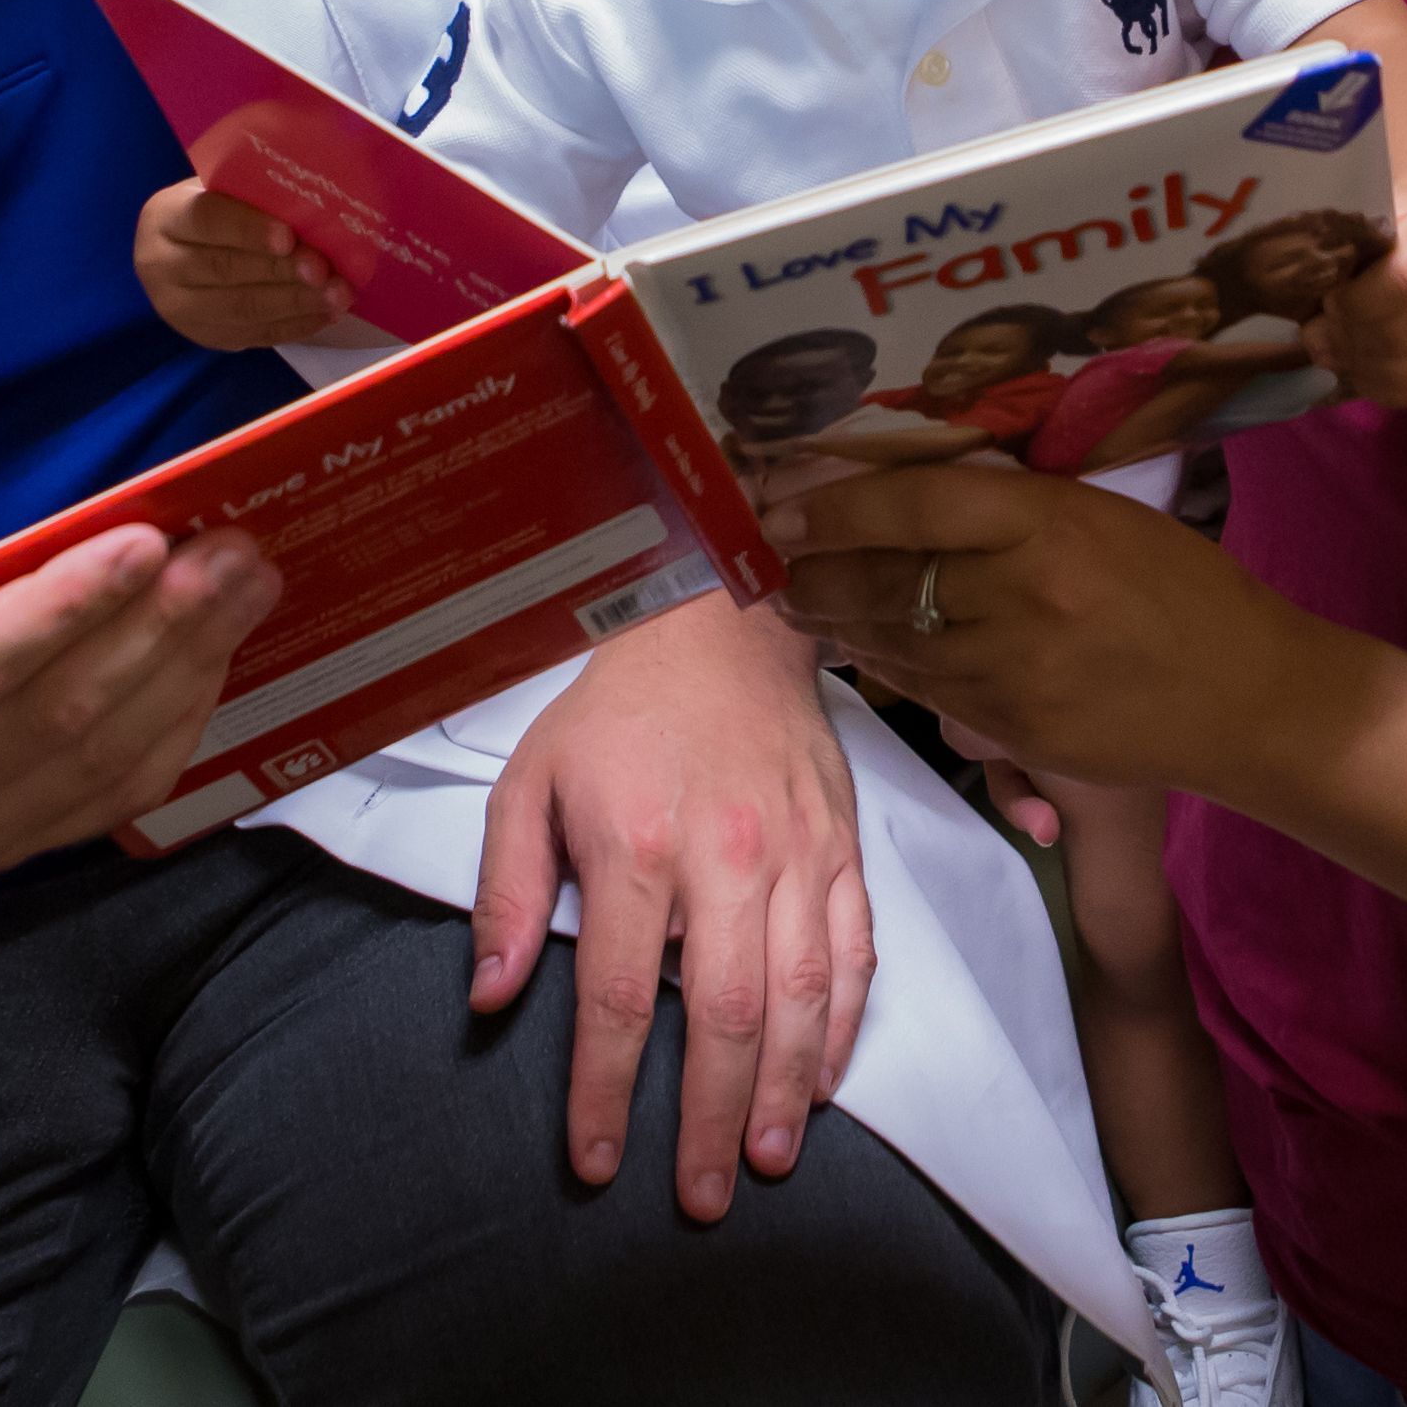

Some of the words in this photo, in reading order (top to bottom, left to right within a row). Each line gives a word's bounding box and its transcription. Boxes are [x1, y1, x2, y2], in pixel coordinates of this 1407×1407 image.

[687, 273, 723, 305] I
[742, 237, 879, 292] Love
[905, 201, 1006, 245] My
[852, 171, 1259, 317] Family
[222, 472, 305, 520] Love
[321, 435, 385, 474] My
[397, 373, 516, 437] Family
